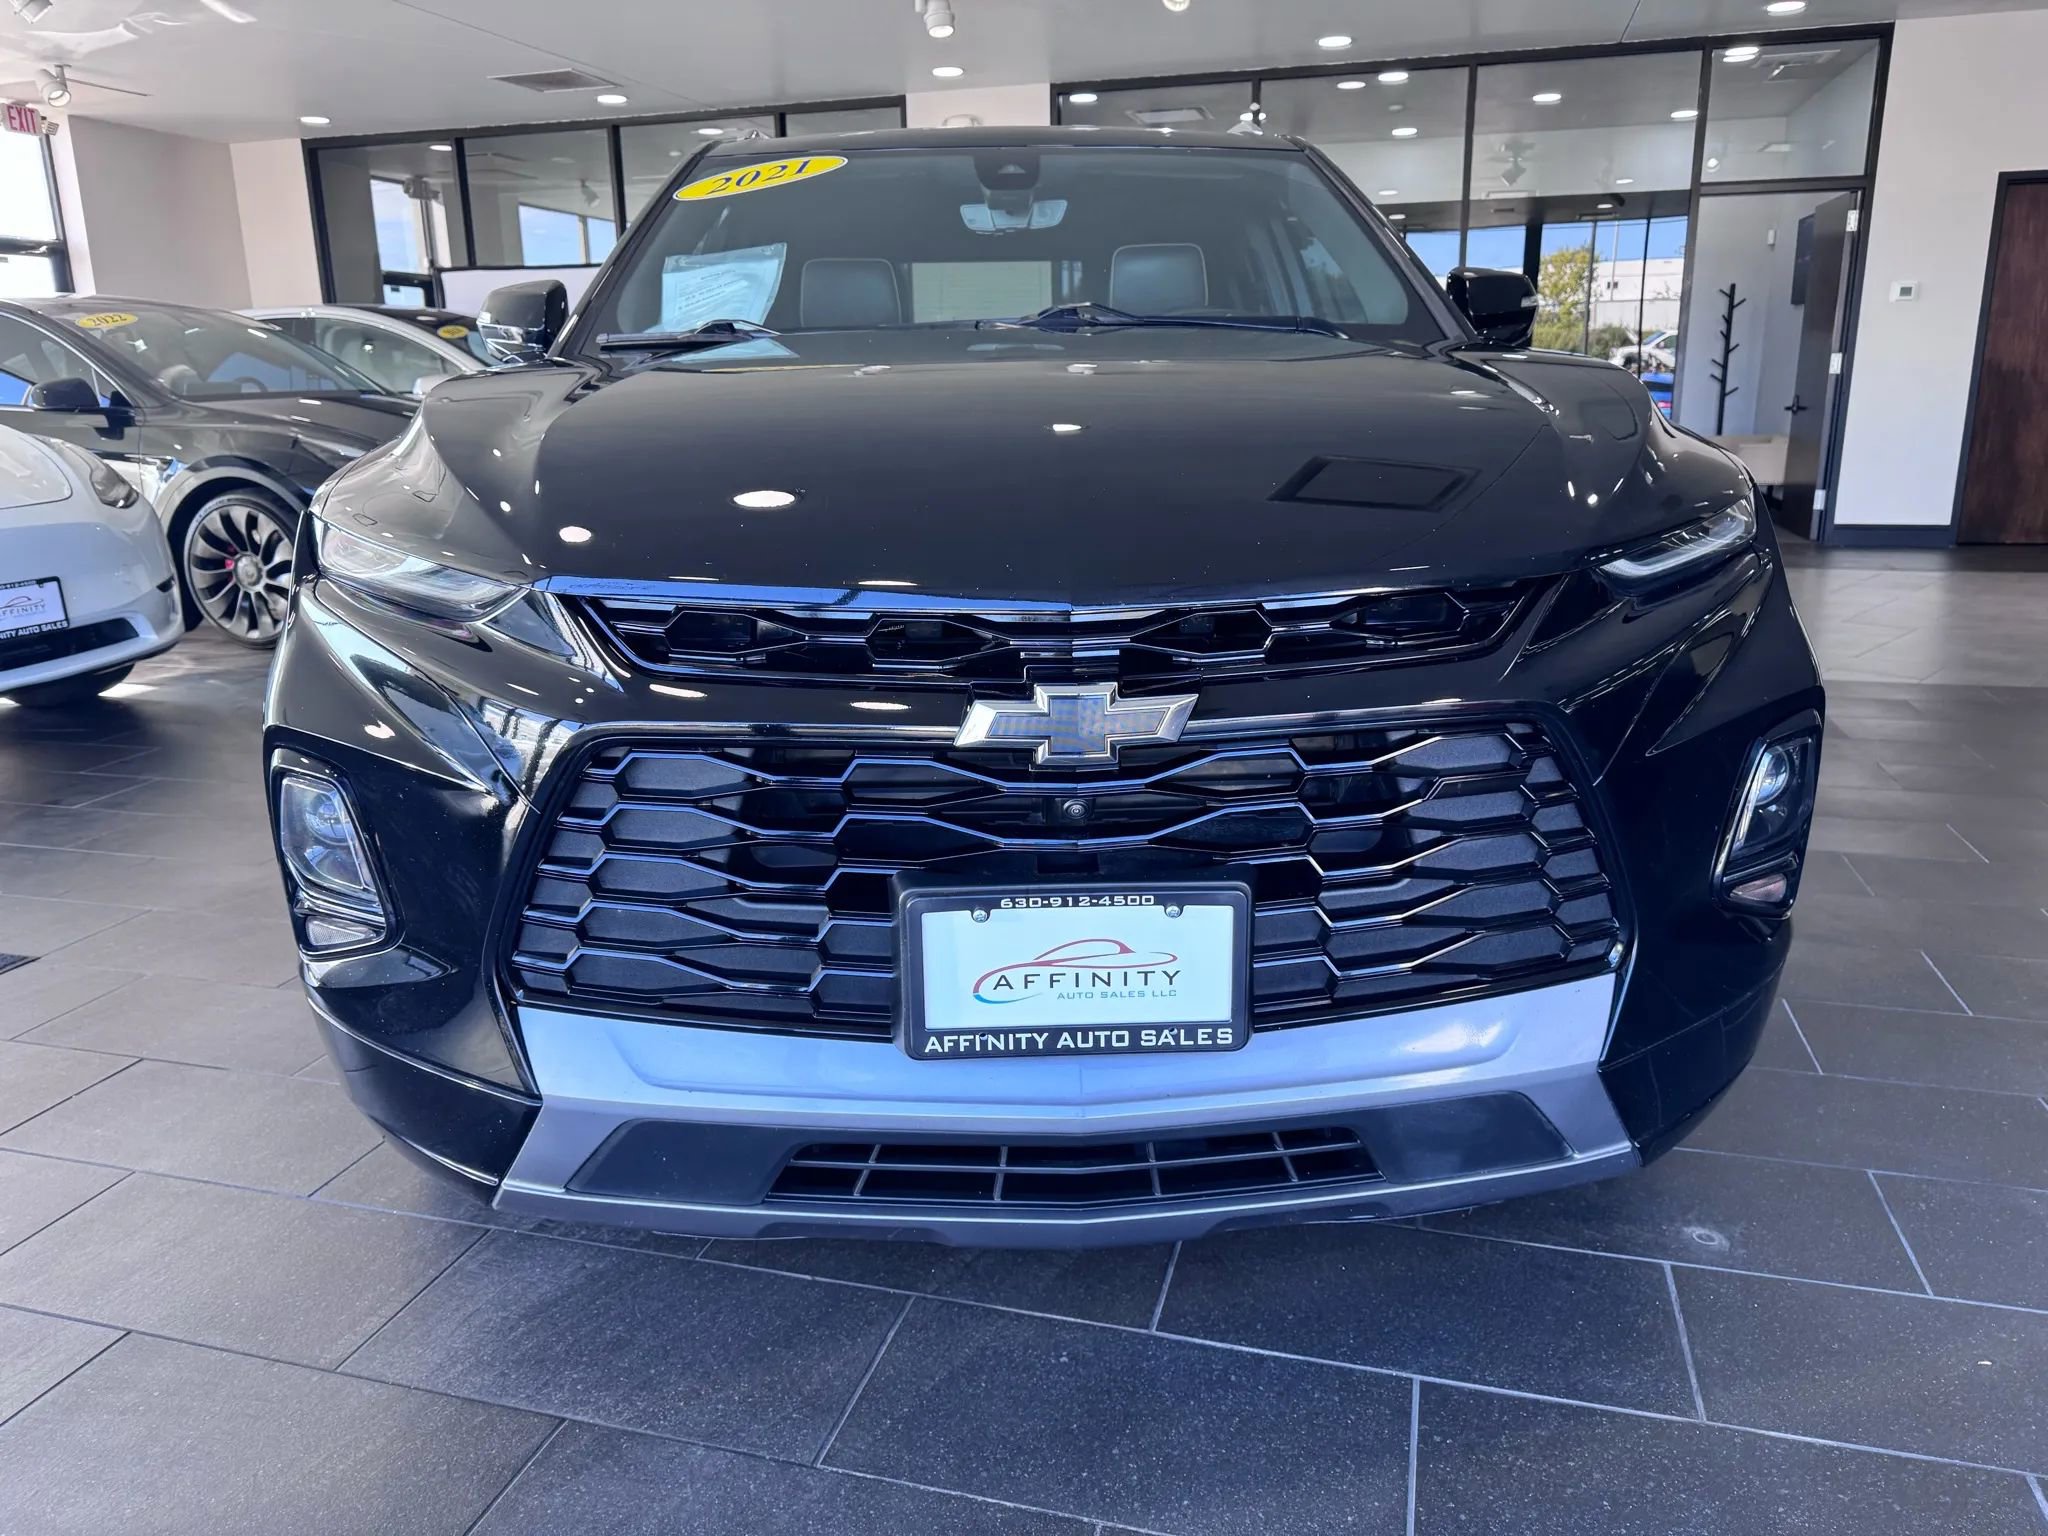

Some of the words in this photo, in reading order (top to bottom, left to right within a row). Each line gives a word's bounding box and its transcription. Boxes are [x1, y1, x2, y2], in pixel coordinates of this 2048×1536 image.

[7, 105, 37, 134] EXIT
[705, 159, 811, 195] 2021
[87, 313, 127, 326] 2022
[0, 604, 46, 617] FFINITY
[17, 626, 40, 636] AUTO
[40, 620, 68, 631] SALES
[1000, 894, 1155, 909] 630-912-4500
[992, 970, 1181, 991] AFFINITY
[1057, 991, 1094, 1000] AUTO
[1100, 989, 1146, 999] SALES
[1152, 989, 1177, 998] LLC
[924, 1031, 1049, 1053] AFFINITY
[1056, 1030, 1130, 1049] AUTO
[1140, 1027, 1233, 1046] SALES
